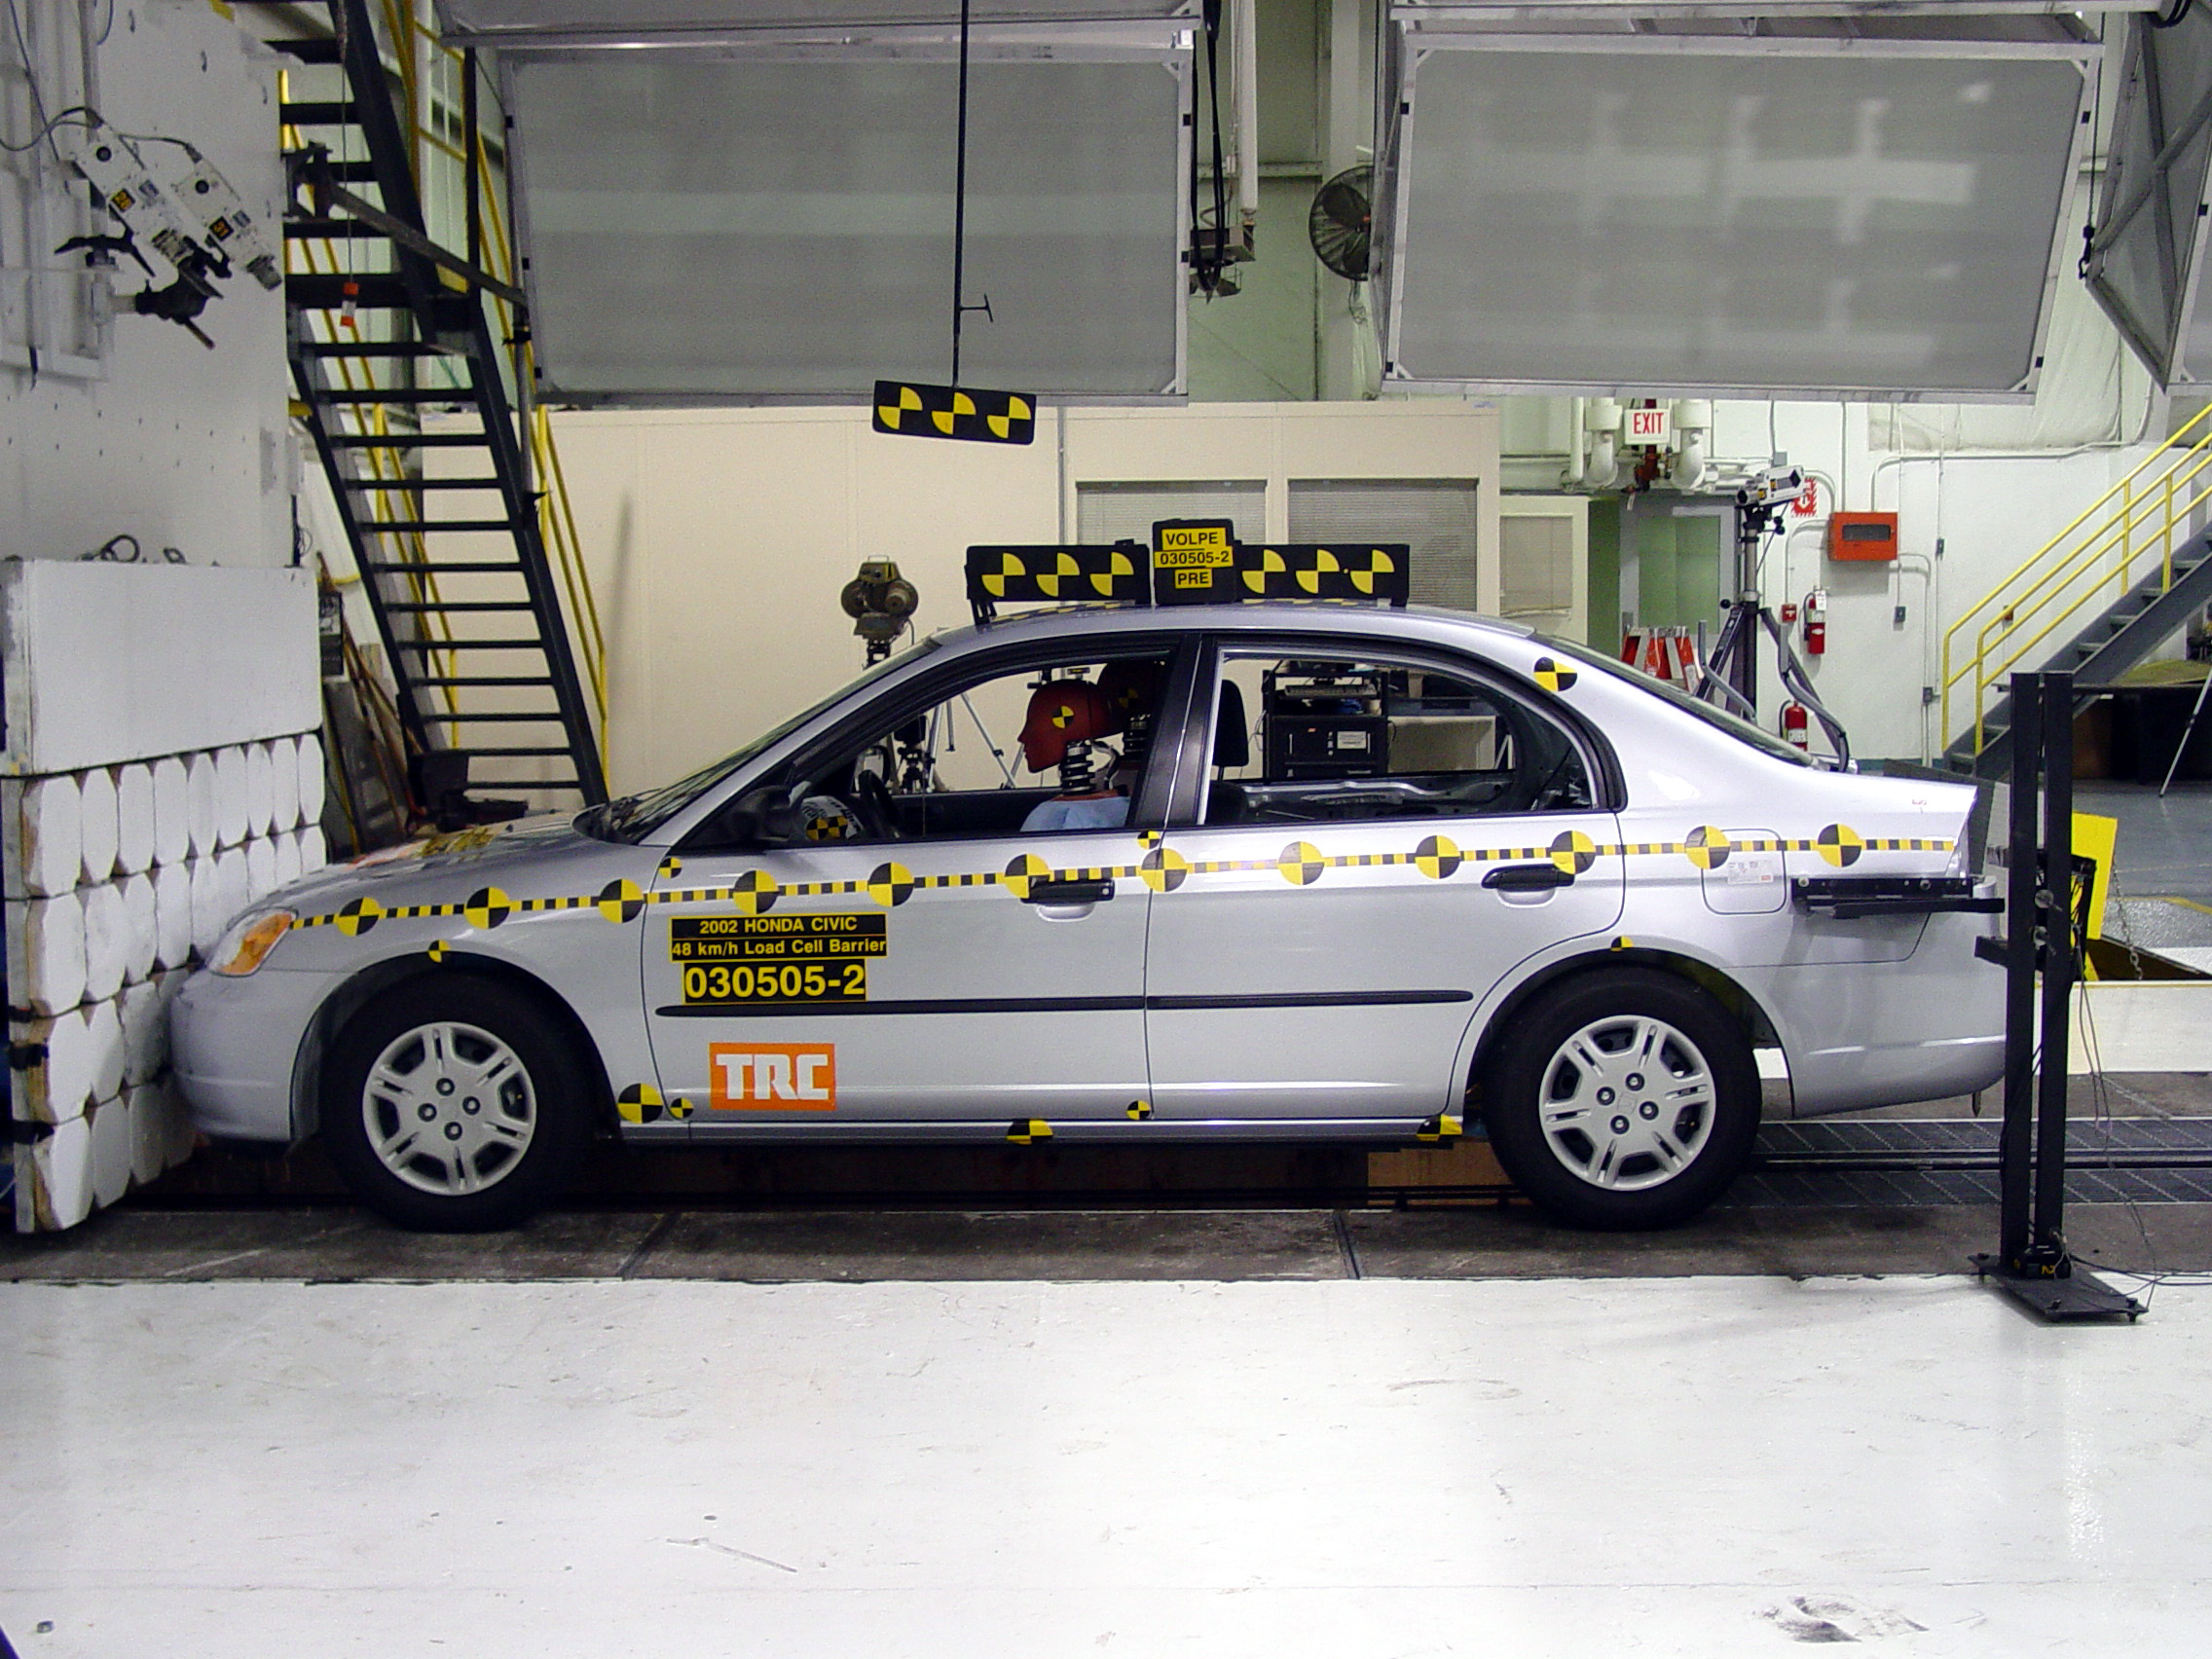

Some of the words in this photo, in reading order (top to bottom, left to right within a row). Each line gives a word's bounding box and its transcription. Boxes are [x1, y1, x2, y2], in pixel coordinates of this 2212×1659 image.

[1633, 412, 1664, 434] EXIT
[1165, 532, 1218, 545] VOLPE
[1160, 550, 1230, 565] 030505-2
[1177, 571, 1209, 585] PRE
[699, 919, 738, 935] 2002
[744, 917, 804, 933] HONDA
[811, 916, 858, 931] CIVIC
[672, 941, 692, 956] 48
[698, 940, 738, 956] km/h
[744, 939, 785, 955] Load
[792, 938, 823, 953] Cell
[829, 937, 886, 952] Barrier
[684, 964, 866, 999] 030505-2
[715, 1053, 830, 1100] TRC
